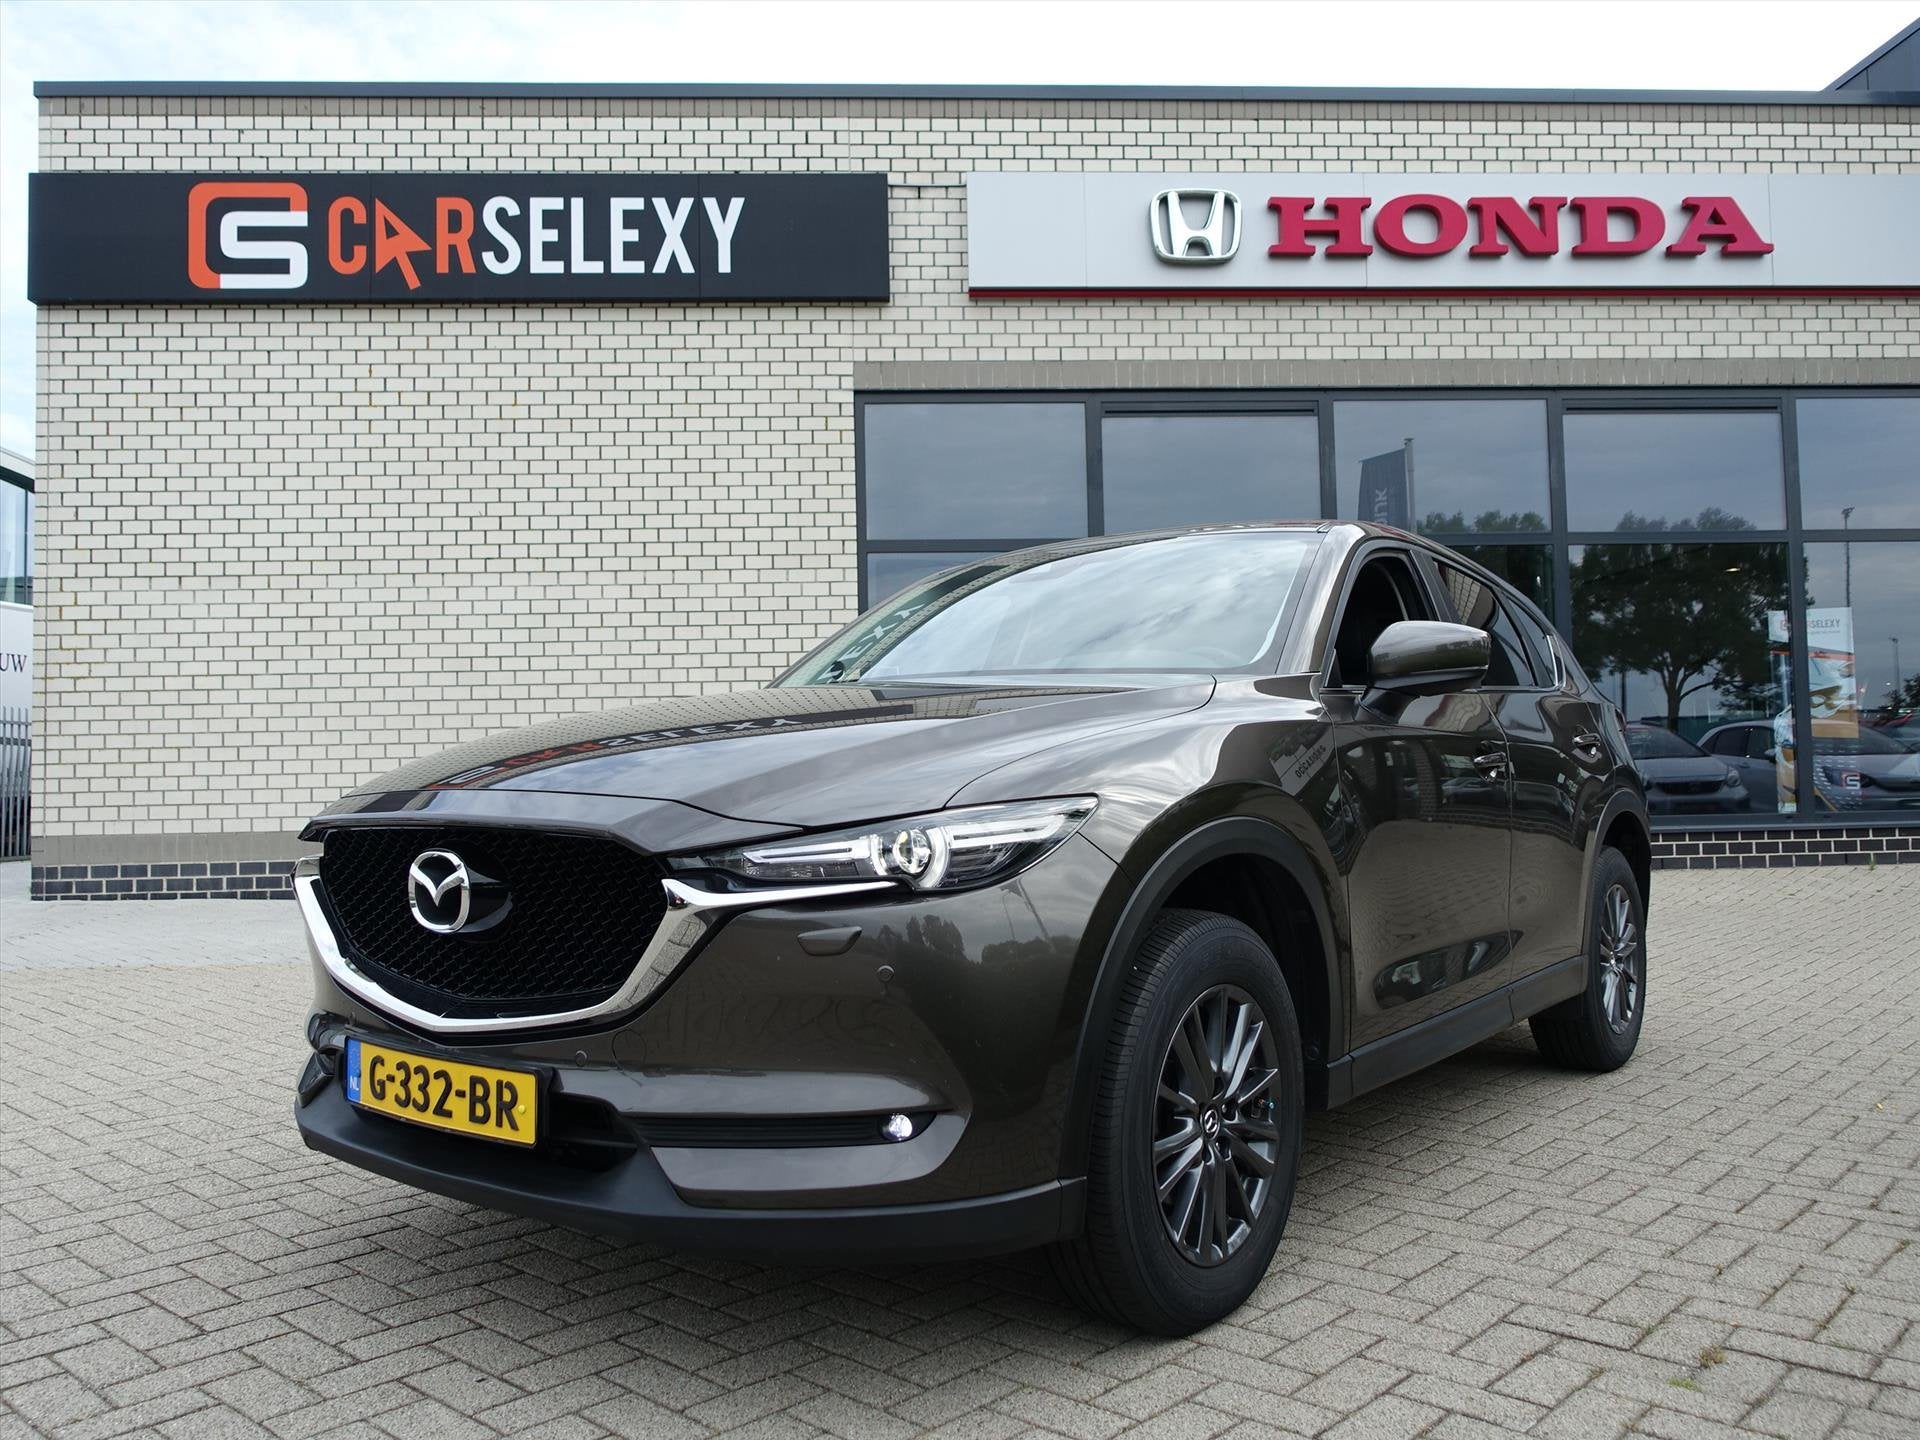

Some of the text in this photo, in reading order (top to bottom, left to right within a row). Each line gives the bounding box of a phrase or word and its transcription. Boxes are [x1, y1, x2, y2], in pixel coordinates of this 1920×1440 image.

[328, 195, 745, 290] CARSELEXY
[1268, 194, 1775, 257] HONDA
[349, 1075, 360, 1091] NL
[369, 1055, 520, 1132] G-332-BR
